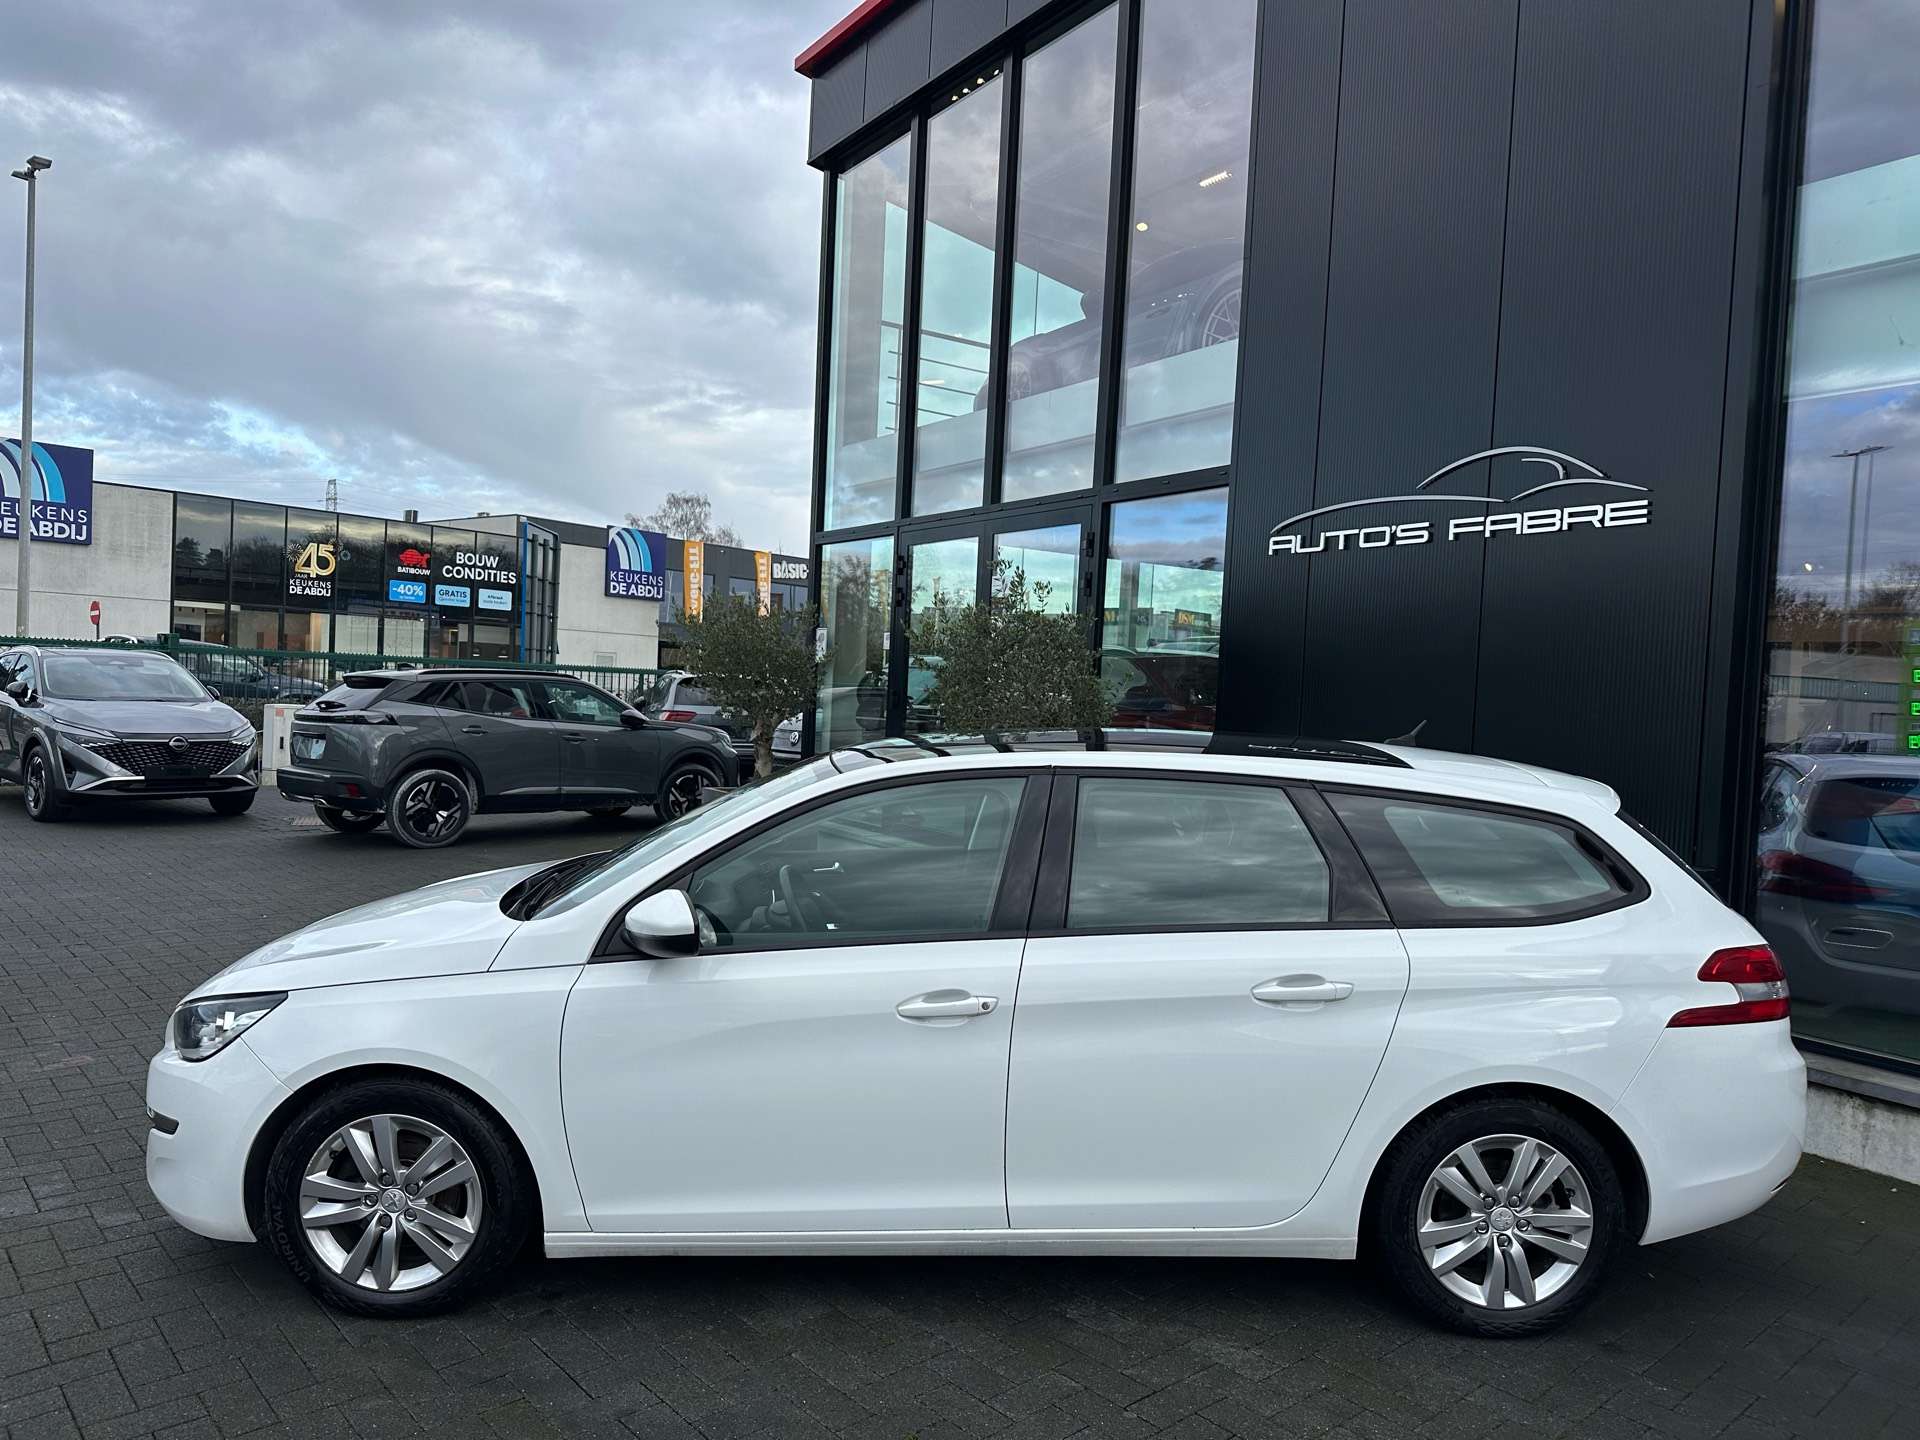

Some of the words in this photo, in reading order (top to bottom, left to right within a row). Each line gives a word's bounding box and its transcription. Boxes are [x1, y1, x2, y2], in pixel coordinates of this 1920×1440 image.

[1268, 521, 1430, 556] AUTO'S
[1448, 499, 1649, 541] FABRE
[295, 542, 336, 578] 45
[456, 551, 499, 569] BOUW
[397, 566, 431, 576] BATIBOUW
[442, 565, 517, 585] CONDITIES
[610, 570, 664, 587] KEUKENS
[289, 578, 332, 589] KEUKENS
[289, 585, 303, 594] DE
[303, 587, 331, 597] ABDIJ
[392, 584, 424, 597] -40%
[610, 581, 627, 595] DE
[628, 584, 663, 599] ABDIJ
[438, 589, 468, 599] GRATIS
